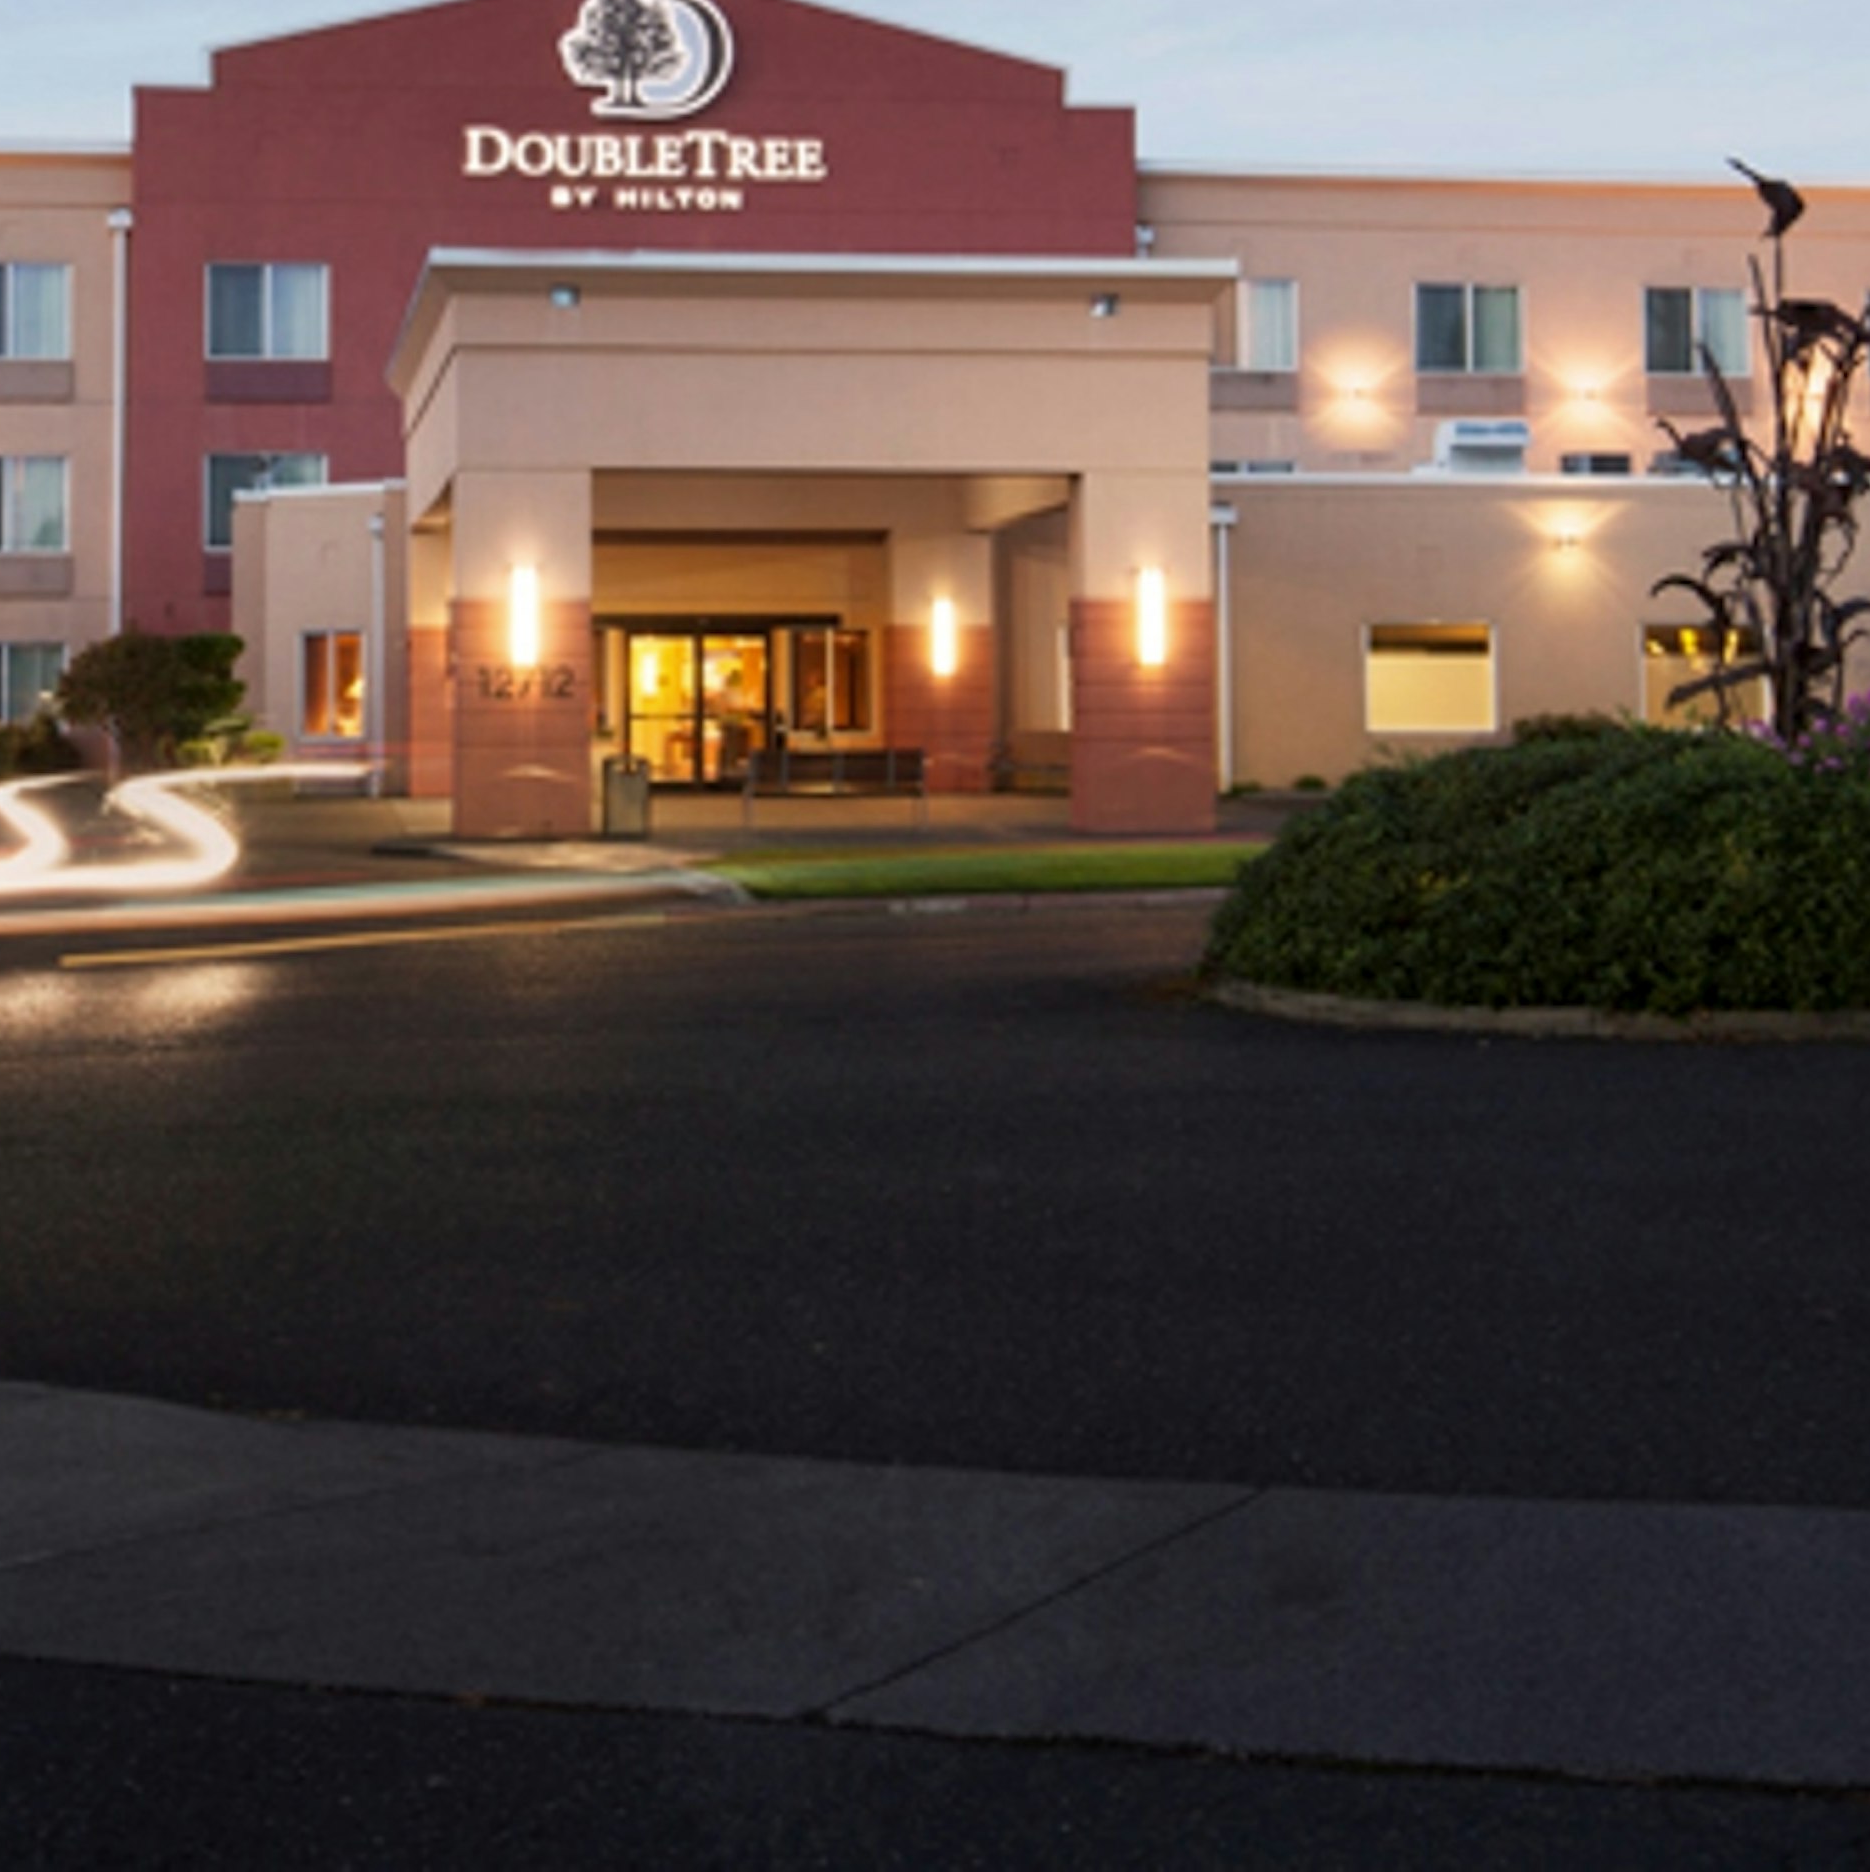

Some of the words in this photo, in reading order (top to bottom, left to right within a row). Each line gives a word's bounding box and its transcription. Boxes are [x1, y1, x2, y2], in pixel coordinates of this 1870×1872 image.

[462, 125, 827, 181] DOUBLETREE
[549, 185, 597, 209] BY
[614, 186, 744, 211] HILTON
